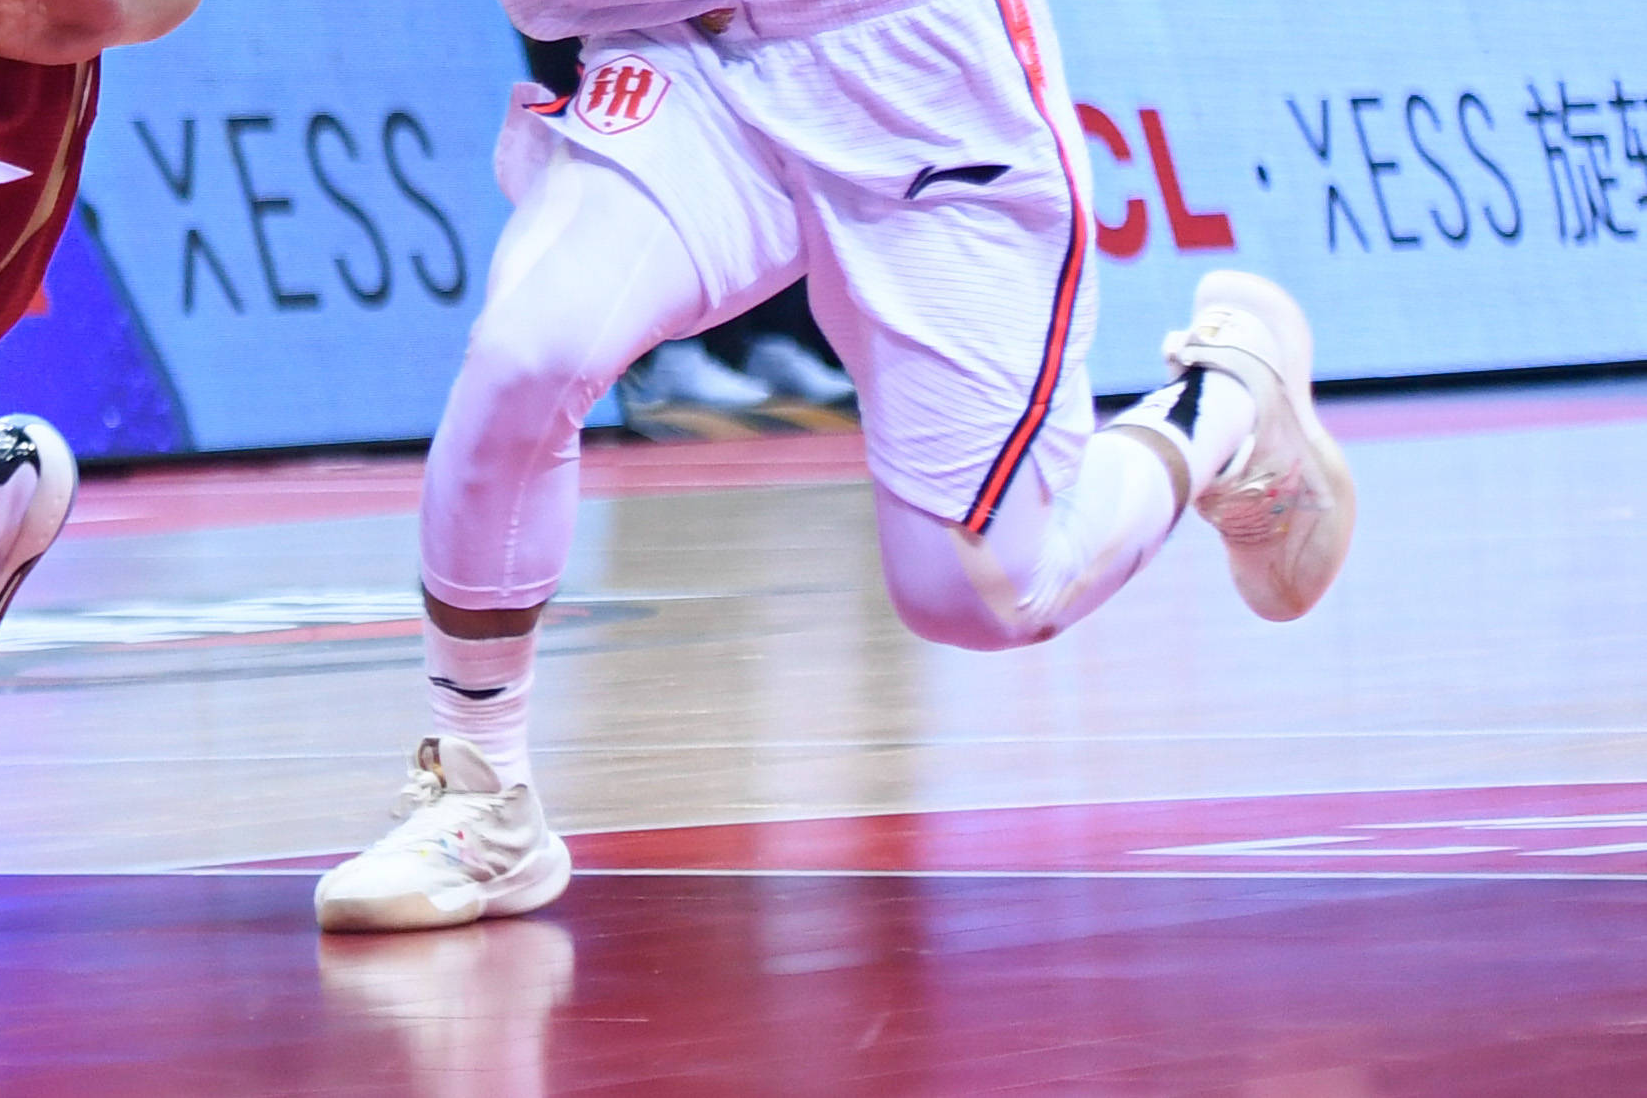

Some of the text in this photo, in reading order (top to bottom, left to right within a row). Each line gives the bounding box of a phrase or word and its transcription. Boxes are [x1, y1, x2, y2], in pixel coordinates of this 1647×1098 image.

[133, 110, 468, 315] XESS
[1074, 103, 1235, 258] CL
[1285, 91, 1523, 252] XESS
